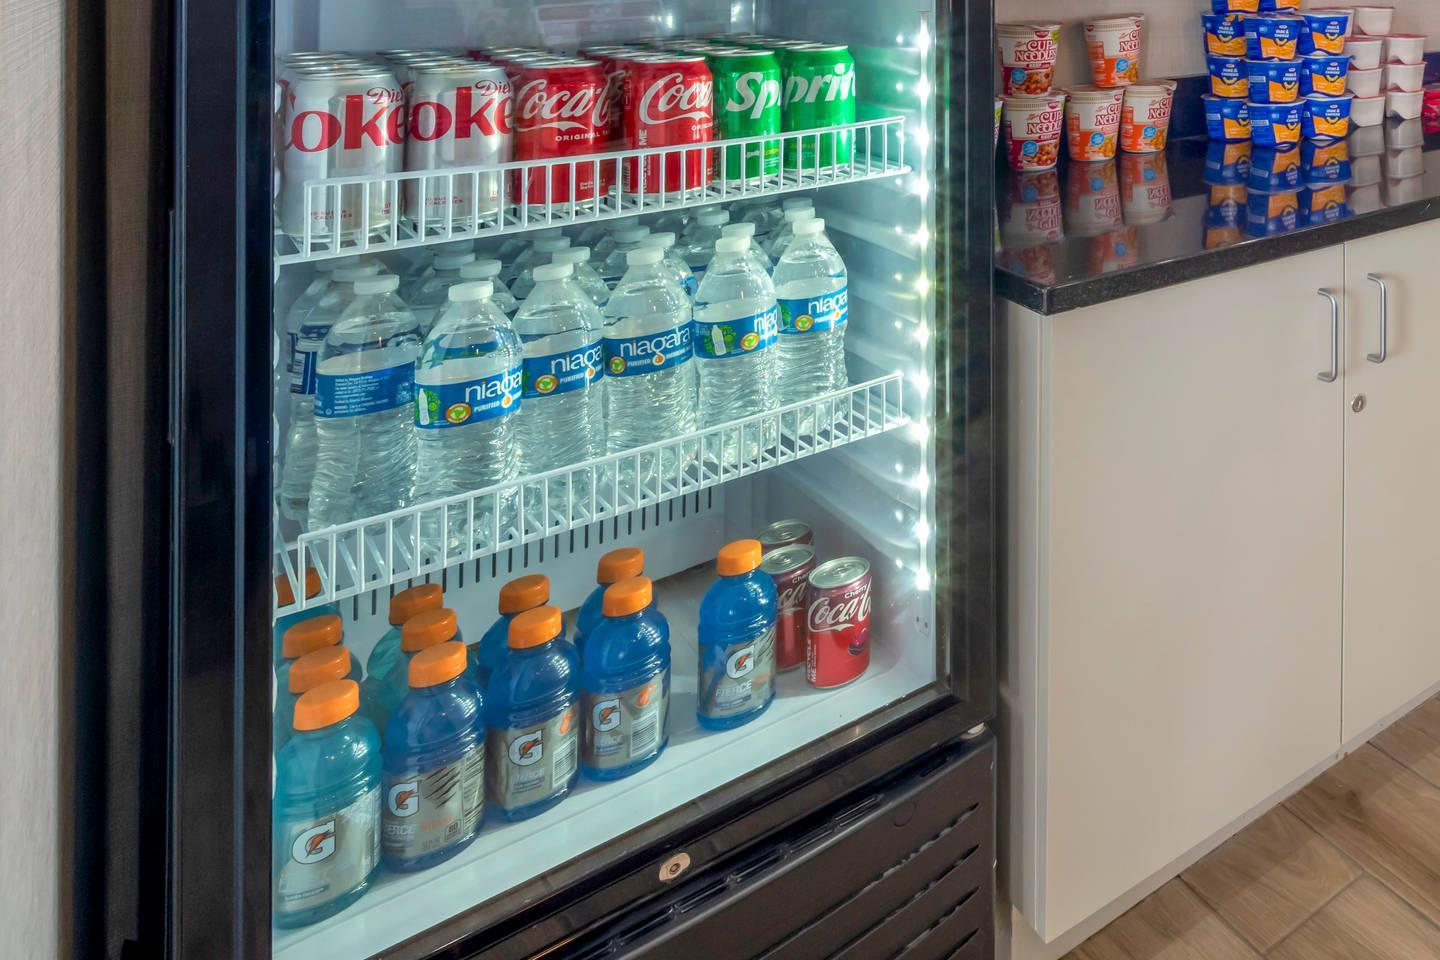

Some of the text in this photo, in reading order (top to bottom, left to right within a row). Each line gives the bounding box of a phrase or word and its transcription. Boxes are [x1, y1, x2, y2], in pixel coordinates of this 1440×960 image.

[1014, 49, 1057, 63] NOODLES
[1026, 39, 1053, 53] CUP
[639, 72, 714, 126] Coca
[725, 71, 782, 119] Sp
[287, 92, 410, 153] oke
[555, 132, 601, 142] ORIGINAL
[619, 327, 691, 359] niagara
[551, 345, 604, 376] niaga
[473, 400, 501, 414] PURIFIED
[844, 582, 870, 600] Cherry
[726, 644, 755, 680] G
[592, 698, 622, 732] G
[507, 728, 545, 767] G
[387, 780, 420, 818] G
[291, 818, 337, 864] G
